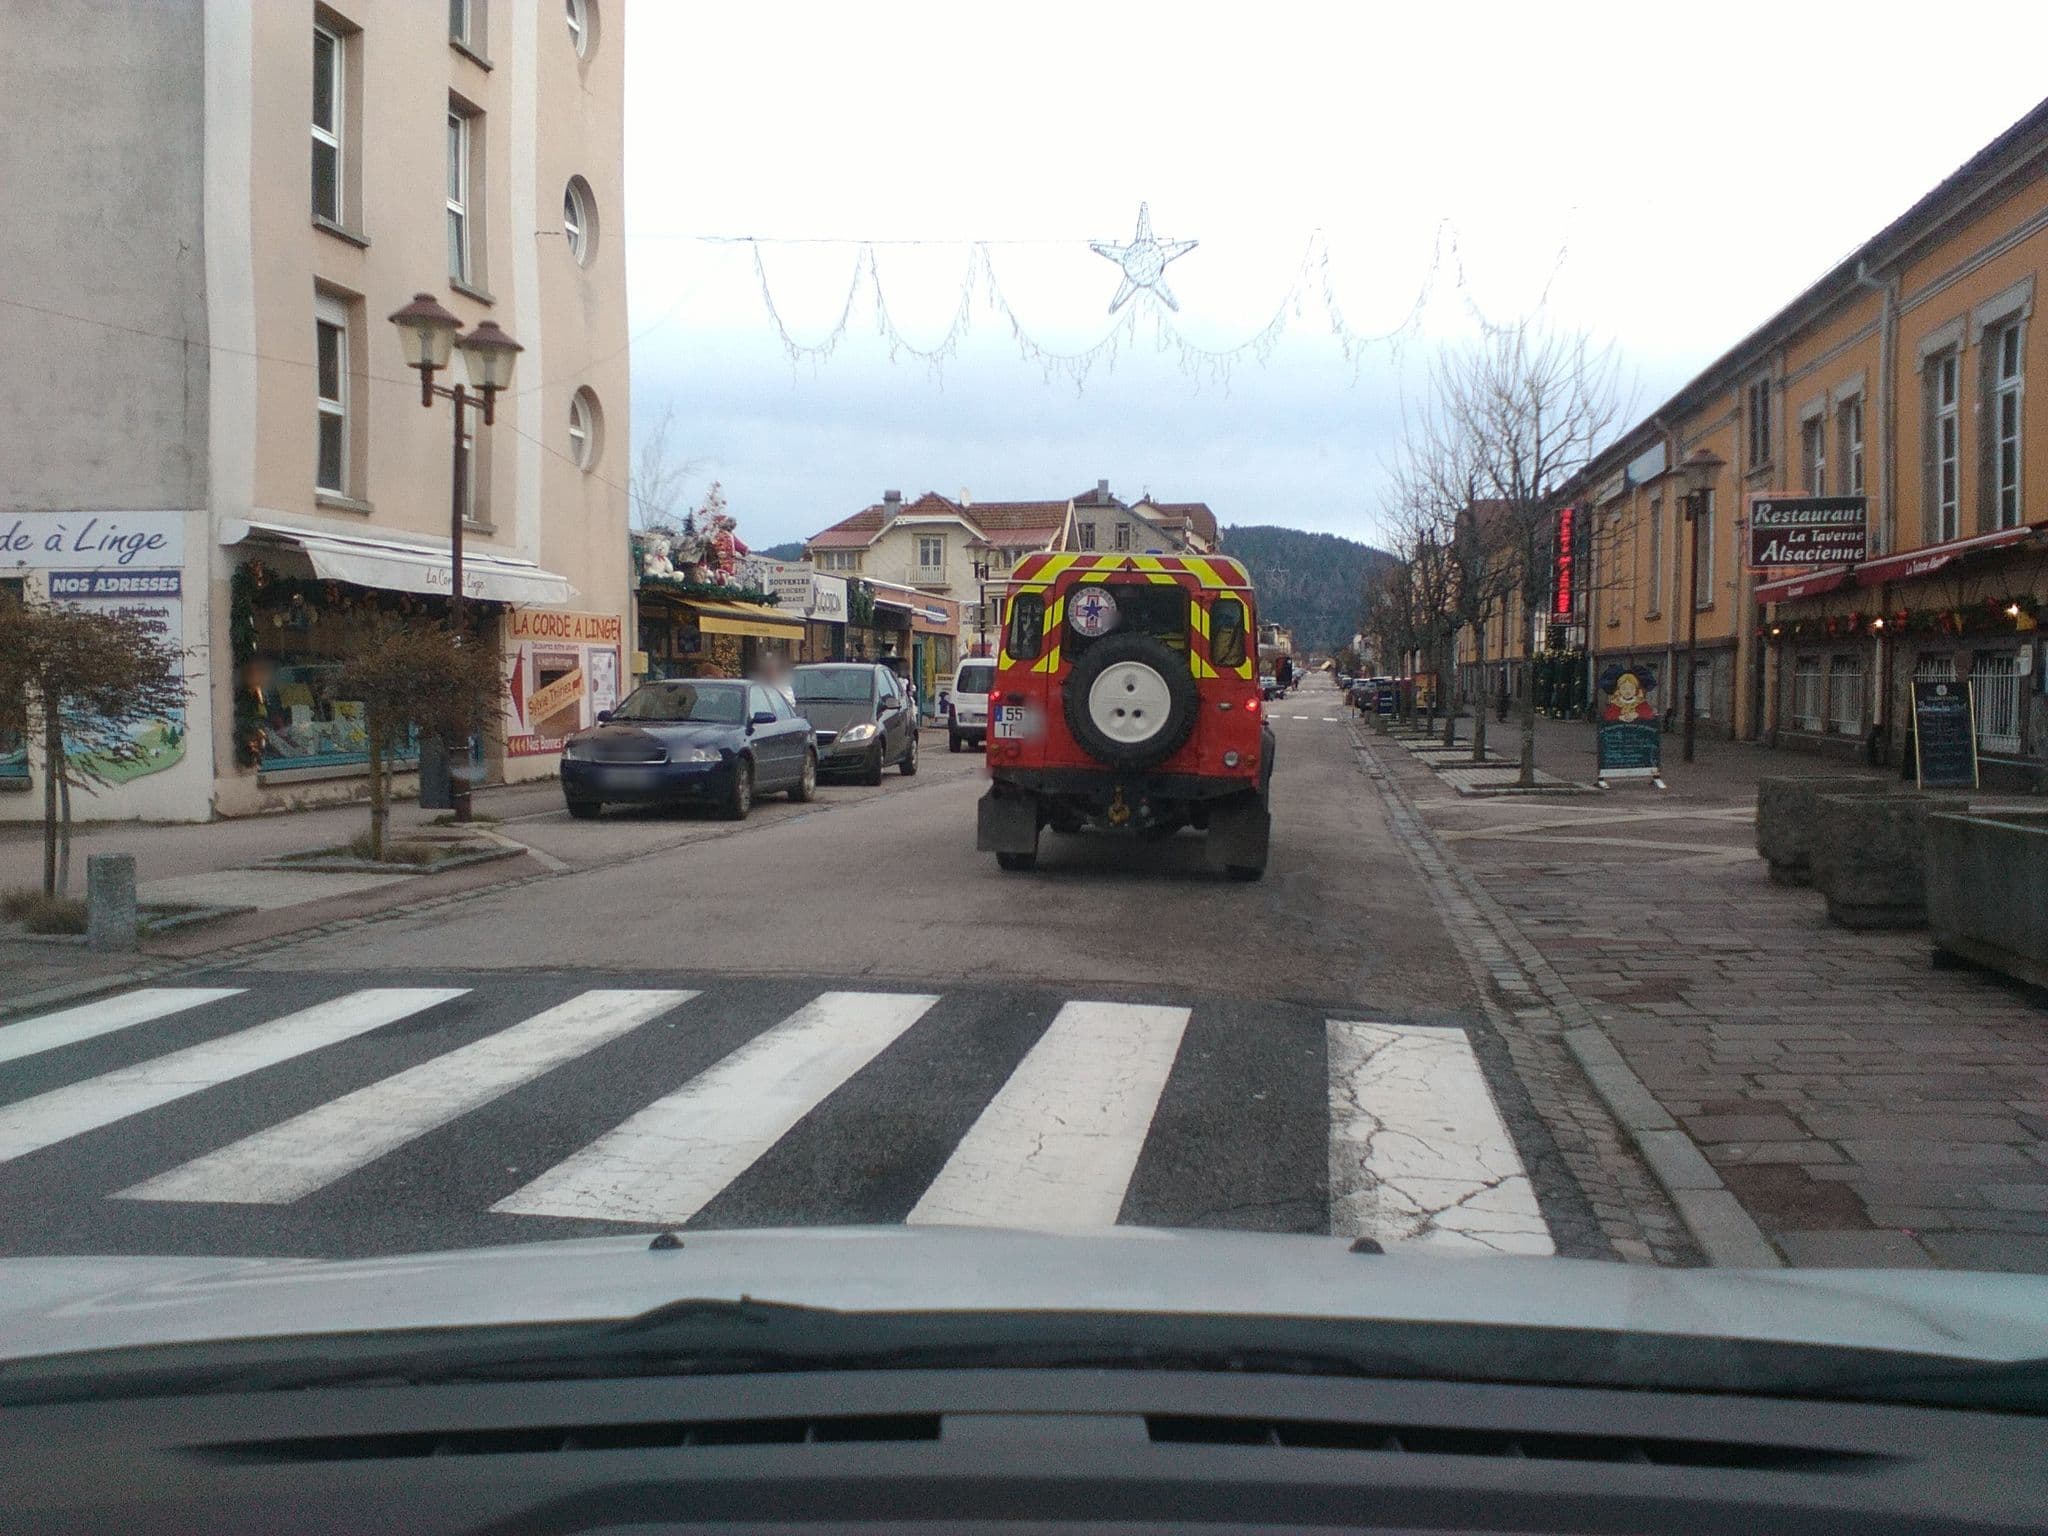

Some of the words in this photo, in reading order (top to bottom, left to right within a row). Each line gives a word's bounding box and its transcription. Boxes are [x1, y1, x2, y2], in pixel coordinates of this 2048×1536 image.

[1754, 503, 1864, 523] Restaurant
[44, 523, 66, 552] à
[73, 518, 168, 565] Linge
[1788, 530, 1807, 543] La
[1811, 529, 1864, 542] Taverne
[1760, 540, 1865, 562] Alsacienne
[53, 578, 90, 593] NOS
[94, 577, 179, 592] ADRESSES
[513, 614, 530, 635] LA
[532, 613, 571, 637] CORDE
[574, 617, 582, 637] A
[585, 617, 617, 640] LINGE
